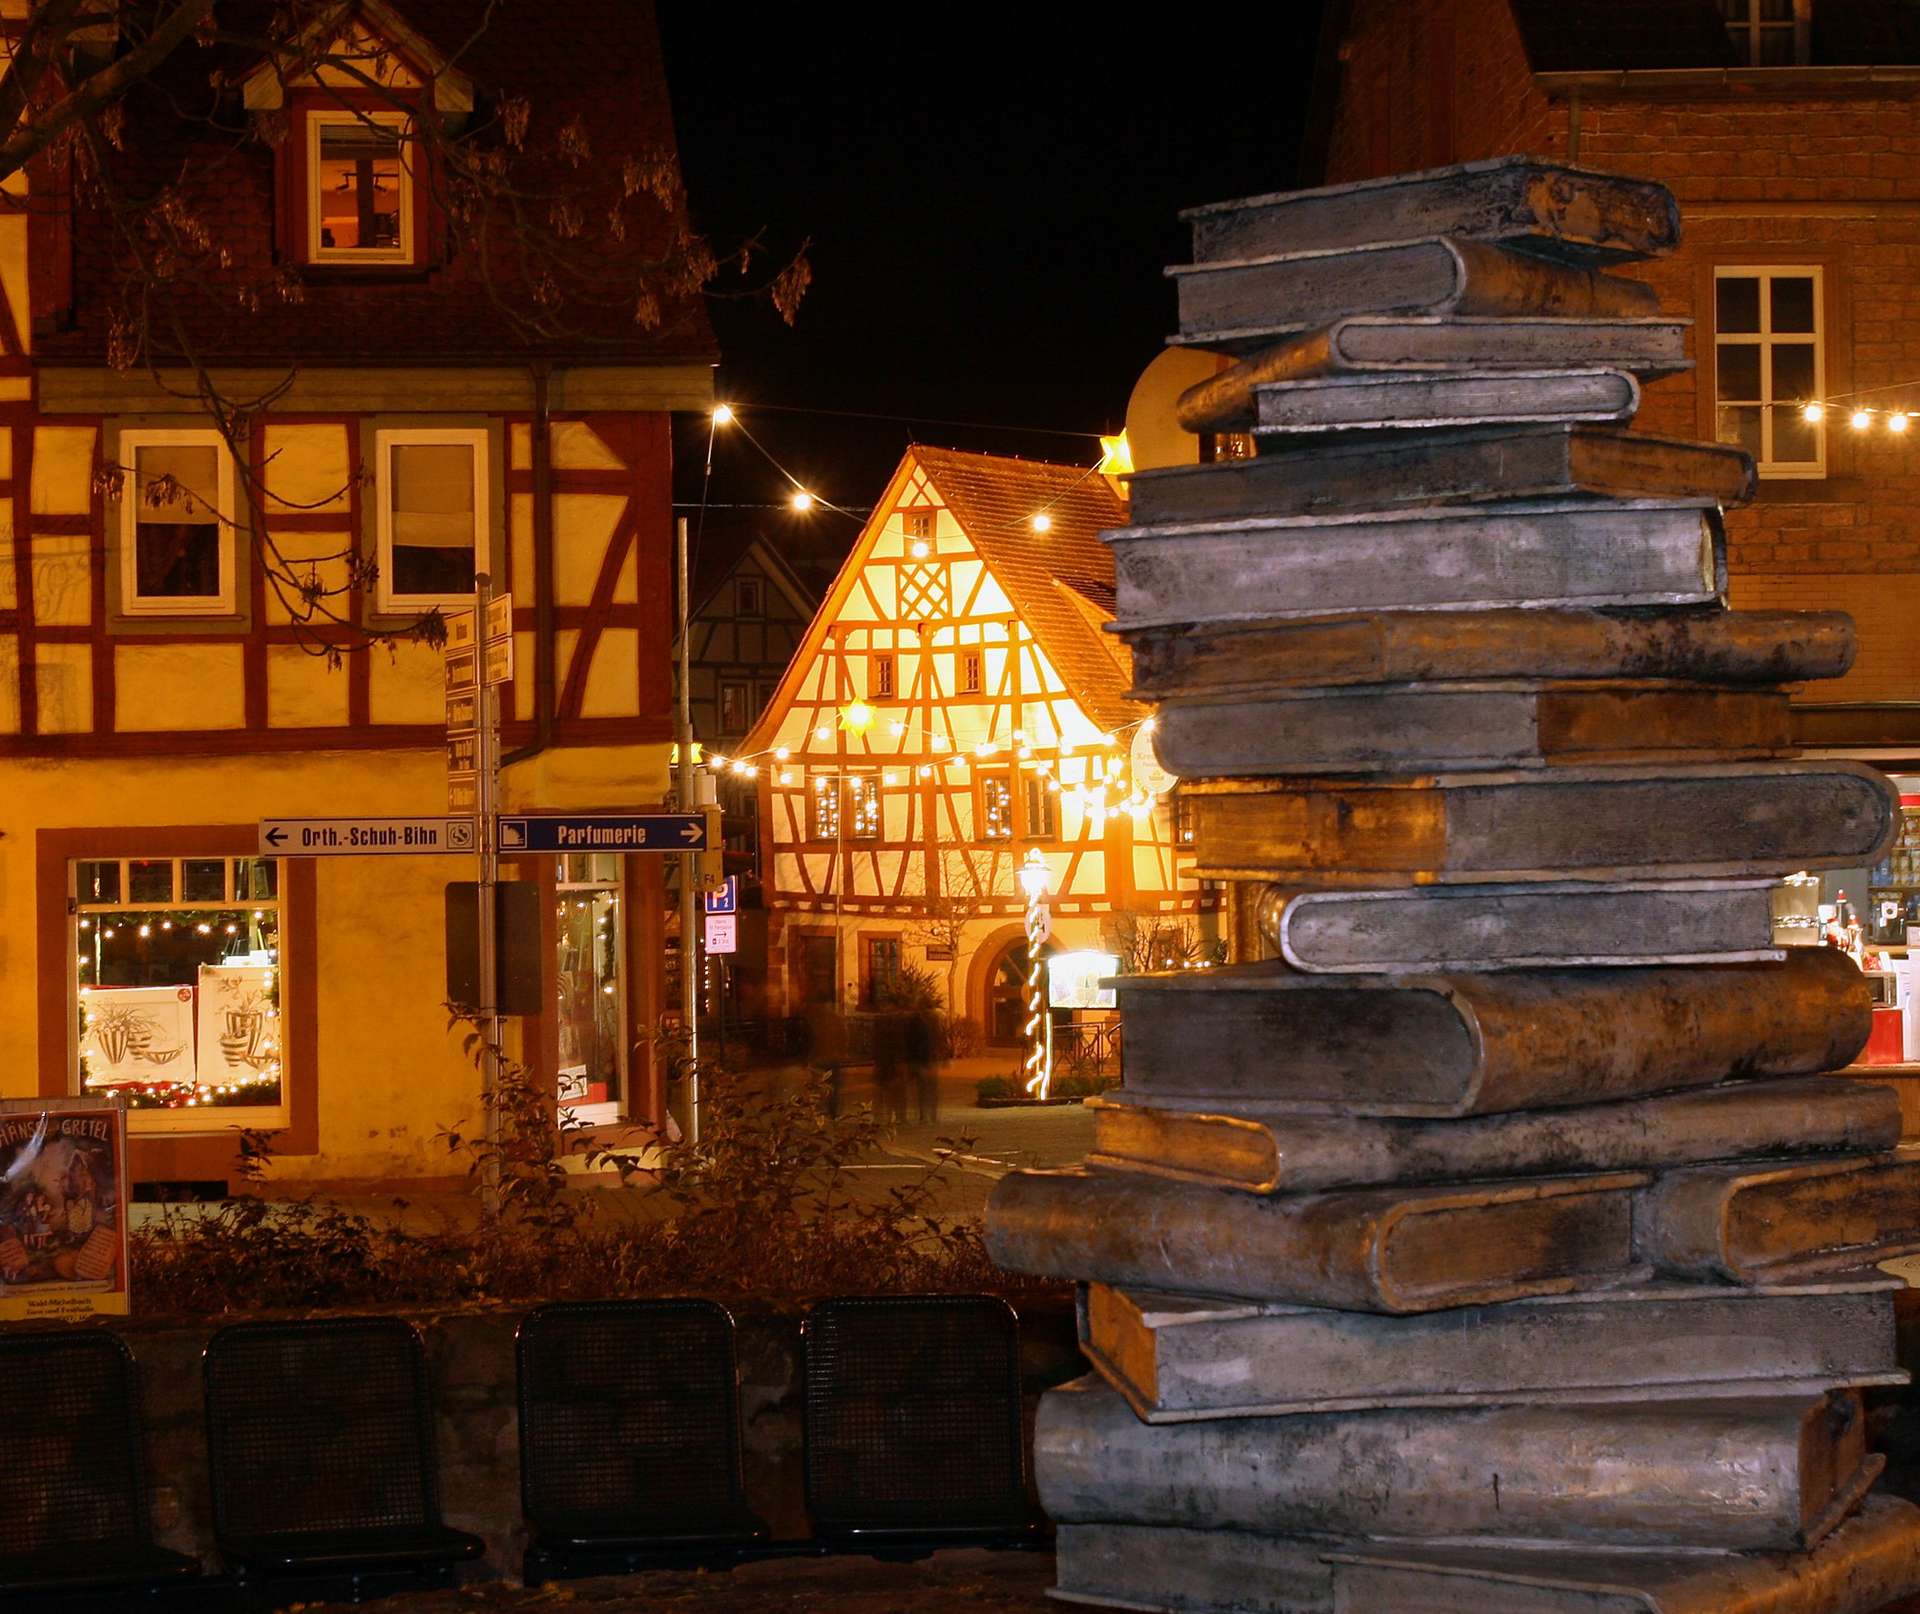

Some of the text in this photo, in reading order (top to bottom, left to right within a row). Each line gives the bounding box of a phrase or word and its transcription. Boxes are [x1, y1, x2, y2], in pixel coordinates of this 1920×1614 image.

[302, 826, 437, 847] Orth.-Schuh-Bihn
[558, 825, 646, 845] Parfumerie
[62, 1119, 108, 1142] GRETEL
